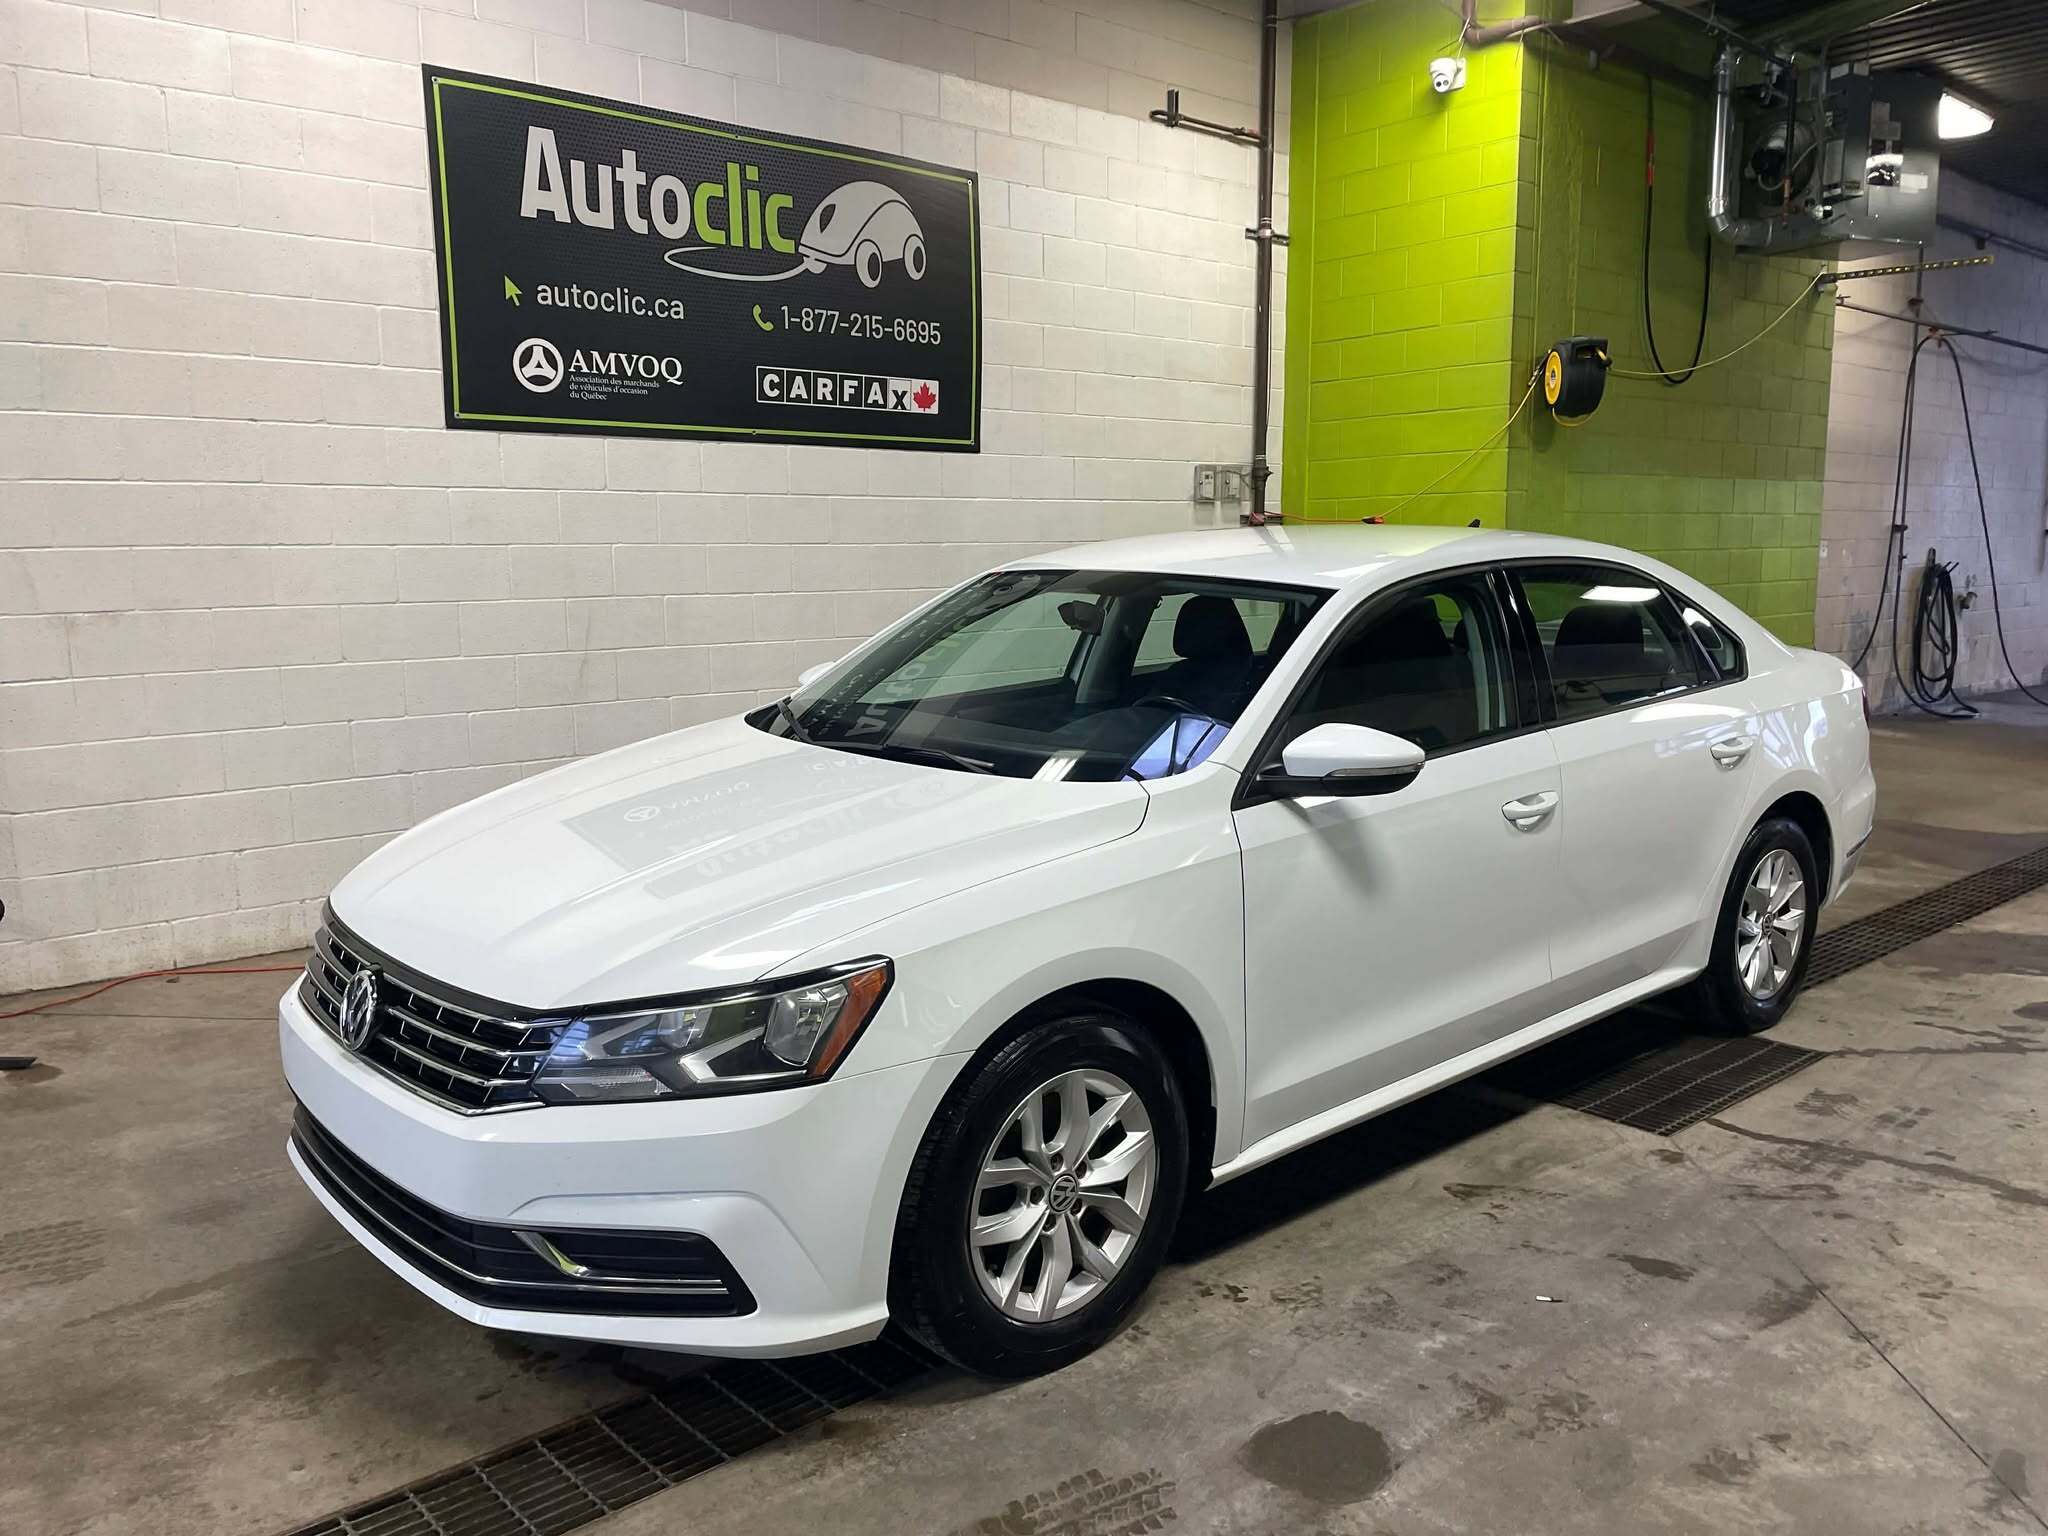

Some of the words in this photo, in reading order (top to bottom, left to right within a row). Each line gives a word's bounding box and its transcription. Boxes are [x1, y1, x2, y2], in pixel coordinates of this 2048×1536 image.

[520, 125, 796, 254] Autoclic
[536, 283, 685, 320] autoclic.ca
[781, 305, 942, 345] 1-877-215-6695
[568, 349, 684, 386] AMVOQ
[569, 375, 608, 384] Association
[609, 377, 622, 386] des
[623, 380, 660, 388] marchands
[579, 383, 612, 393] véhicules
[580, 391, 608, 401] Québec
[762, 373, 908, 410] CARFAX
